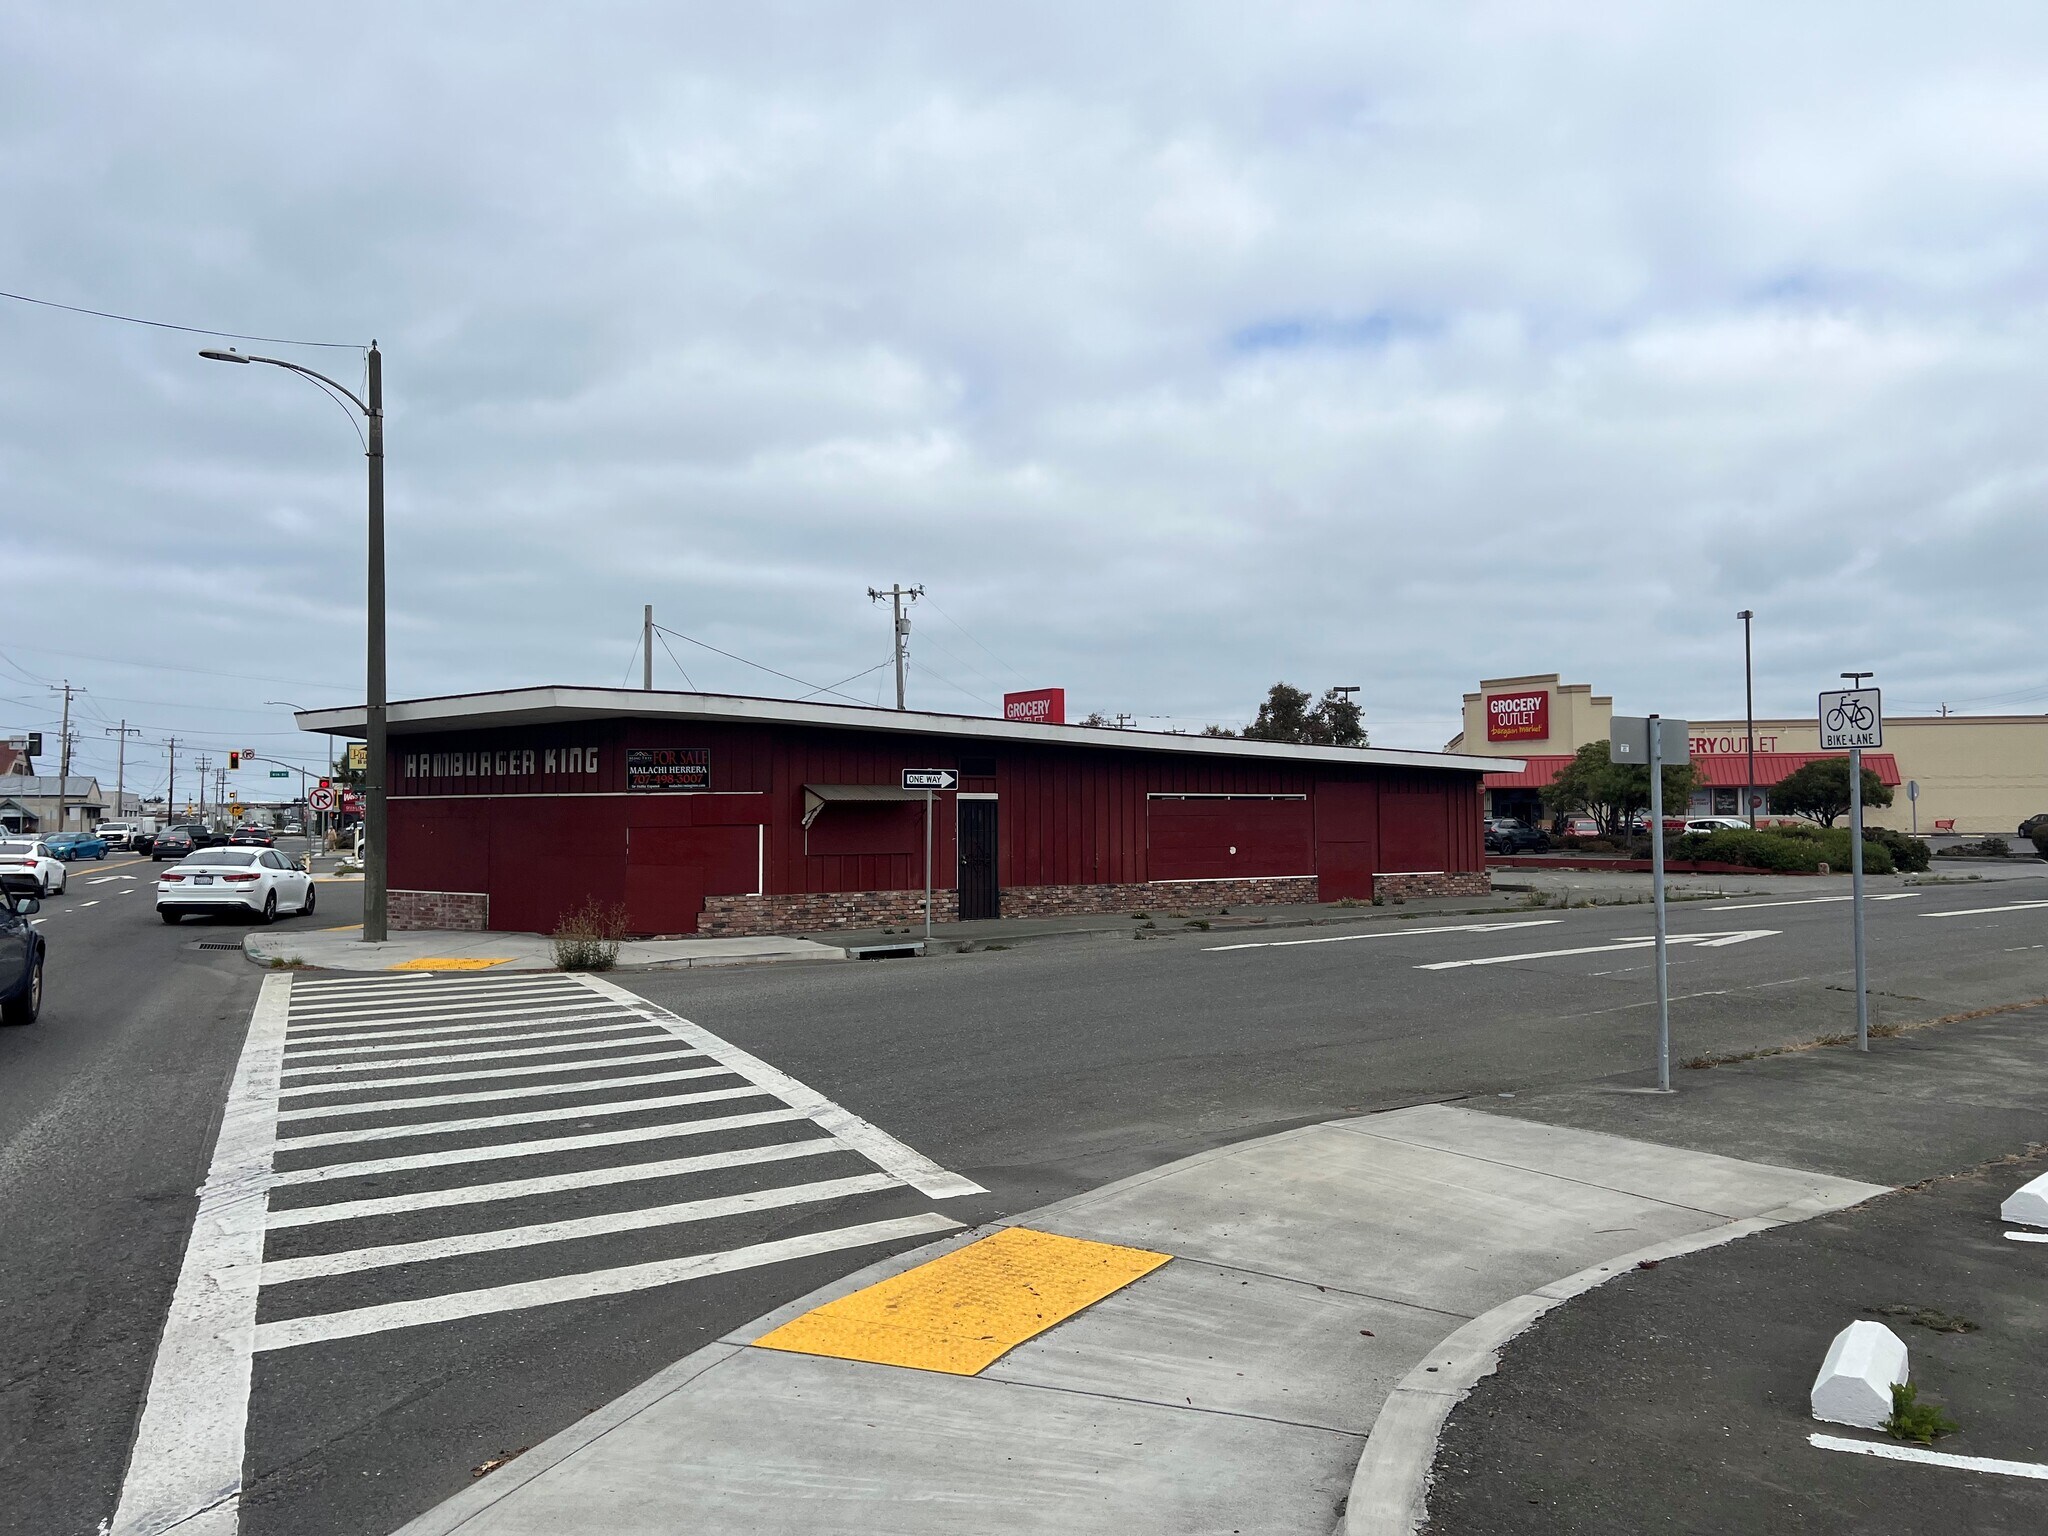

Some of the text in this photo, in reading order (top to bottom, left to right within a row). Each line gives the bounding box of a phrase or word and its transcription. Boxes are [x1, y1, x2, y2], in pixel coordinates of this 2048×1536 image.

[1007, 699, 1051, 718] GROCERY
[1490, 697, 1542, 713] GROCERY
[1498, 711, 1535, 726] OUTLET
[1490, 724, 1542, 738] bargain market
[1719, 736, 1778, 753] OUTLET
[1828, 733, 1874, 746] BIKE LANE
[544, 746, 599, 774] KING
[653, 750, 677, 765] FOR
[680, 750, 708, 765] SALE
[629, 765, 707, 774] MALACHI HERRERA
[633, 774, 703, 784] 707-498-3007
[908, 775, 942, 783] ONE WAY
